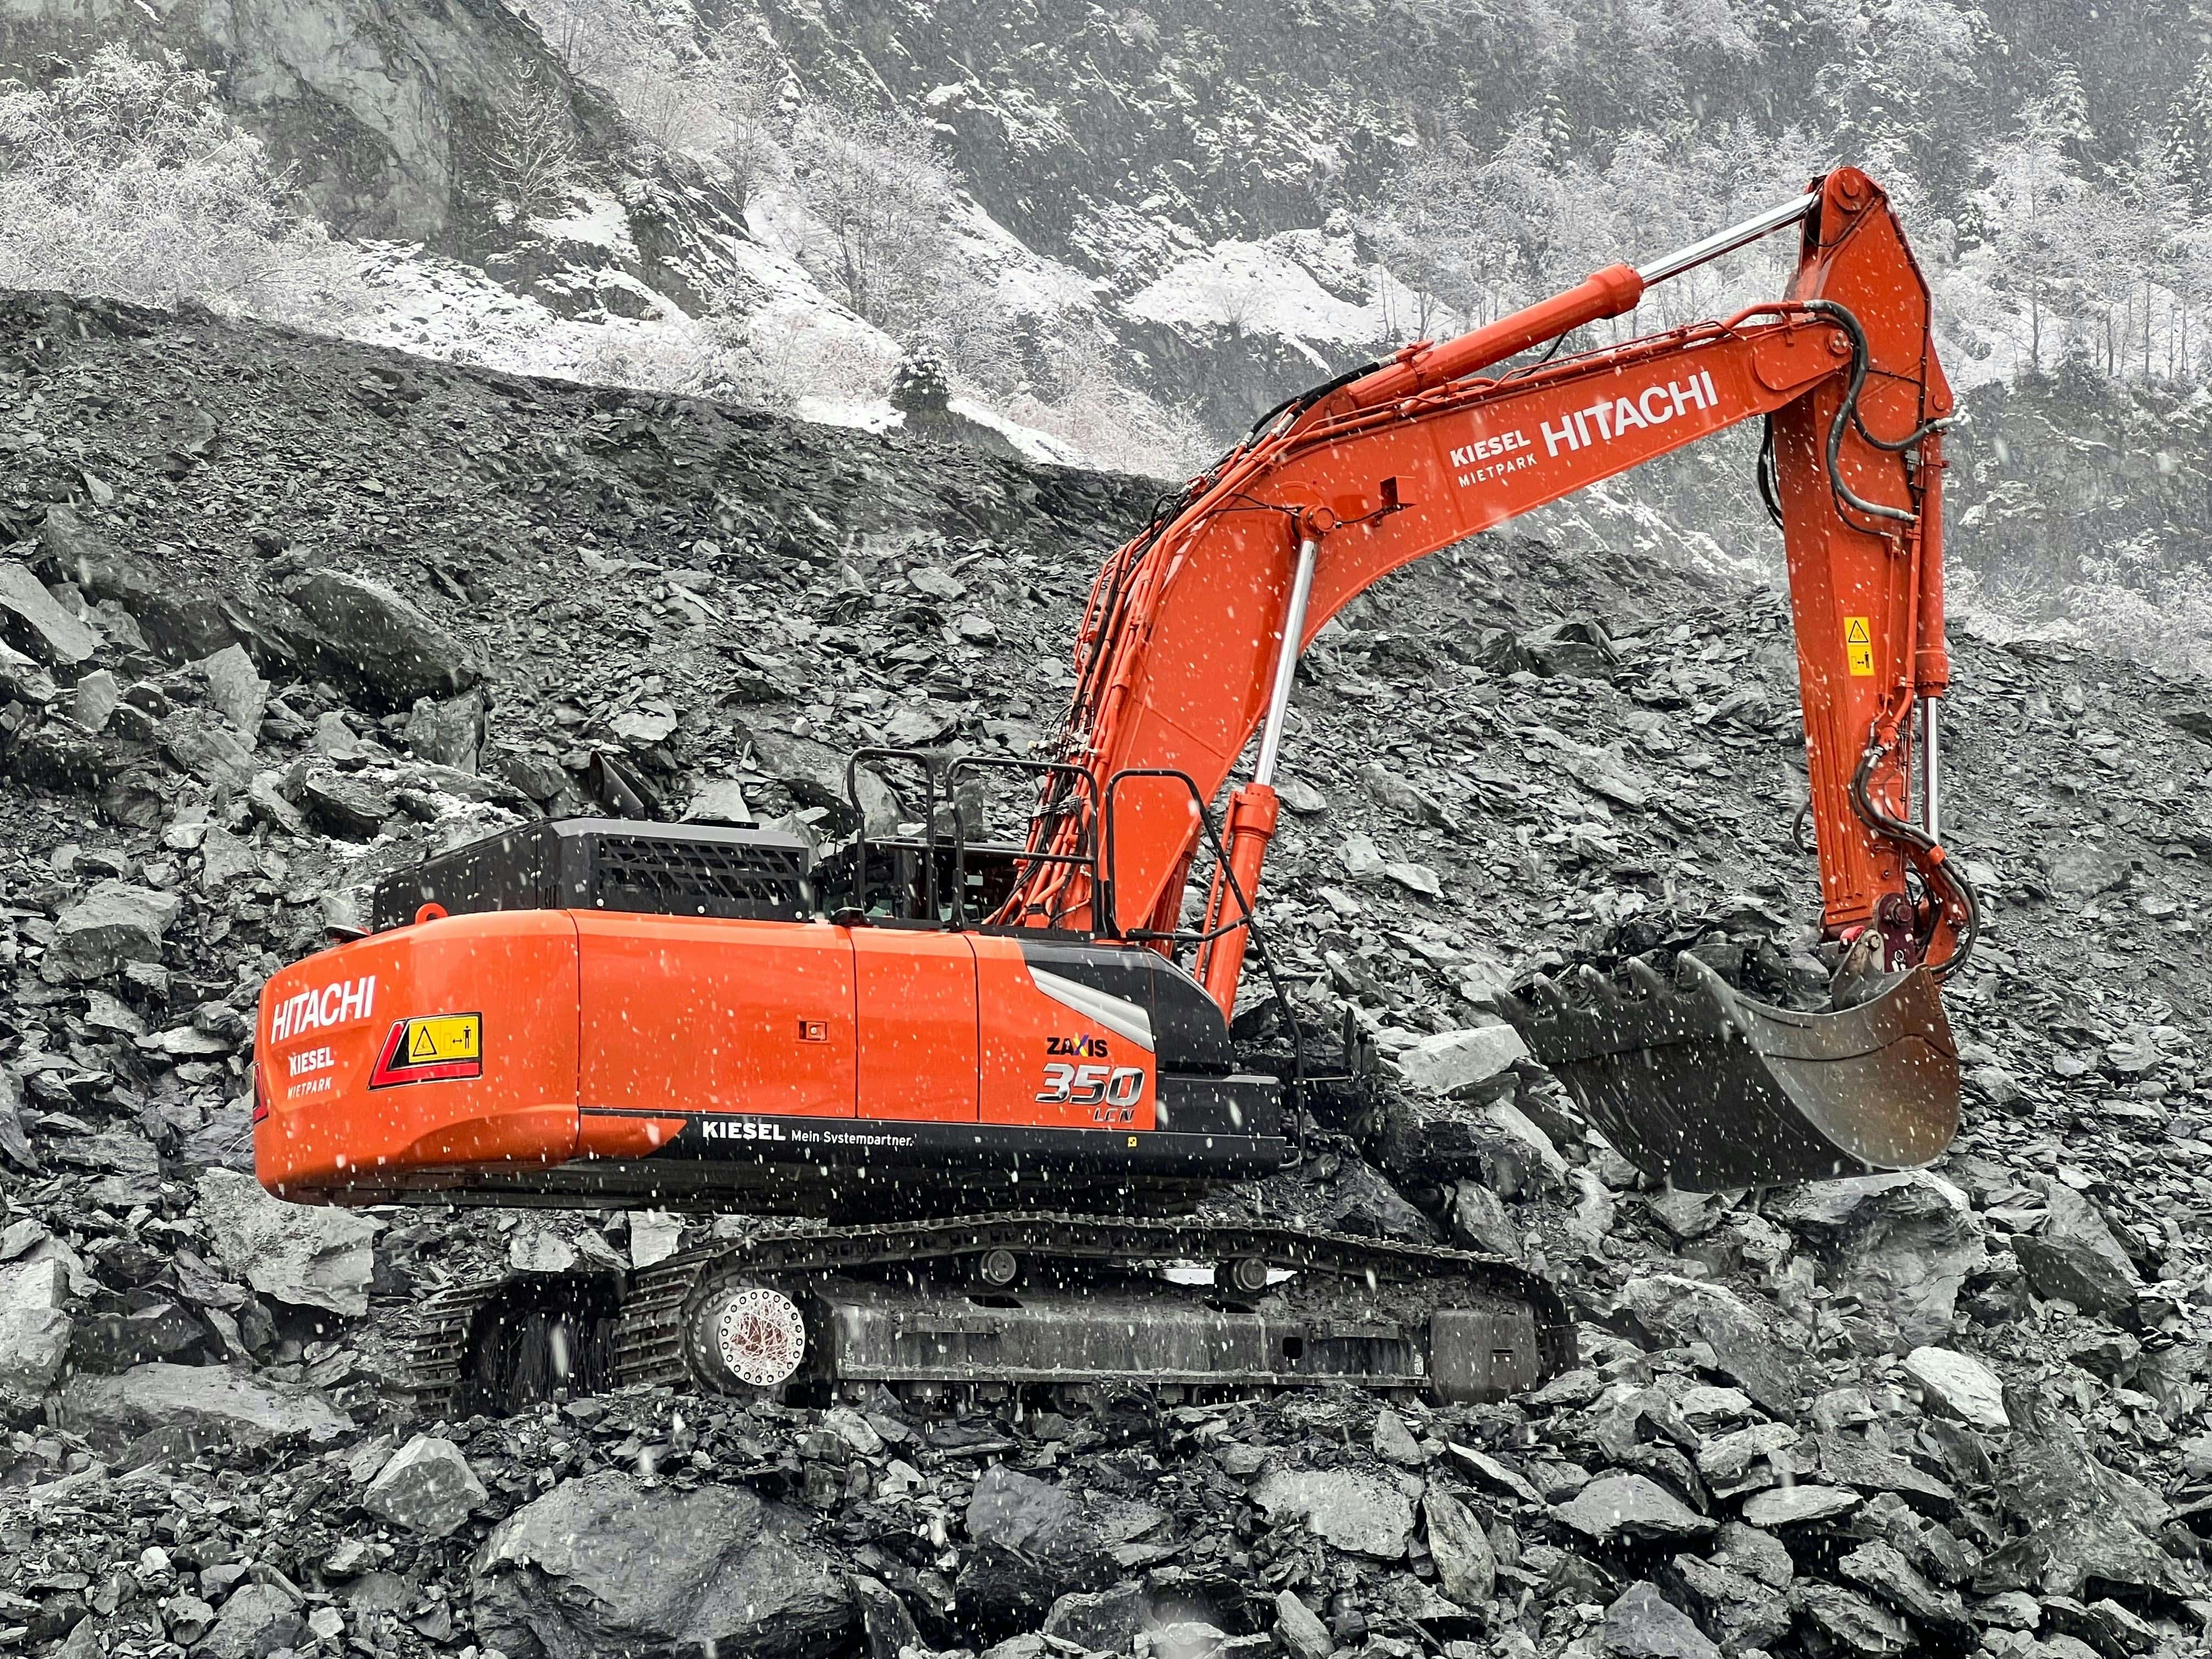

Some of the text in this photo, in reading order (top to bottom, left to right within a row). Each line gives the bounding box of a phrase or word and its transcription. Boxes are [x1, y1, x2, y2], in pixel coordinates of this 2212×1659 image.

[1540, 370, 1719, 458] HITACHI
[1450, 430, 1531, 468] KIESEL
[1458, 453, 1537, 488] MIETPARK
[270, 975, 376, 1045] HITACHI
[288, 1046, 334, 1077] KIESEL
[1046, 1034, 1108, 1058] ZAXIS
[286, 1076, 332, 1101] MIETPARK
[1035, 1063, 1145, 1106] 350
[1092, 1107, 1134, 1123] LCN
[702, 1121, 786, 1141] KIESEL
[791, 1130, 820, 1143] Mein
